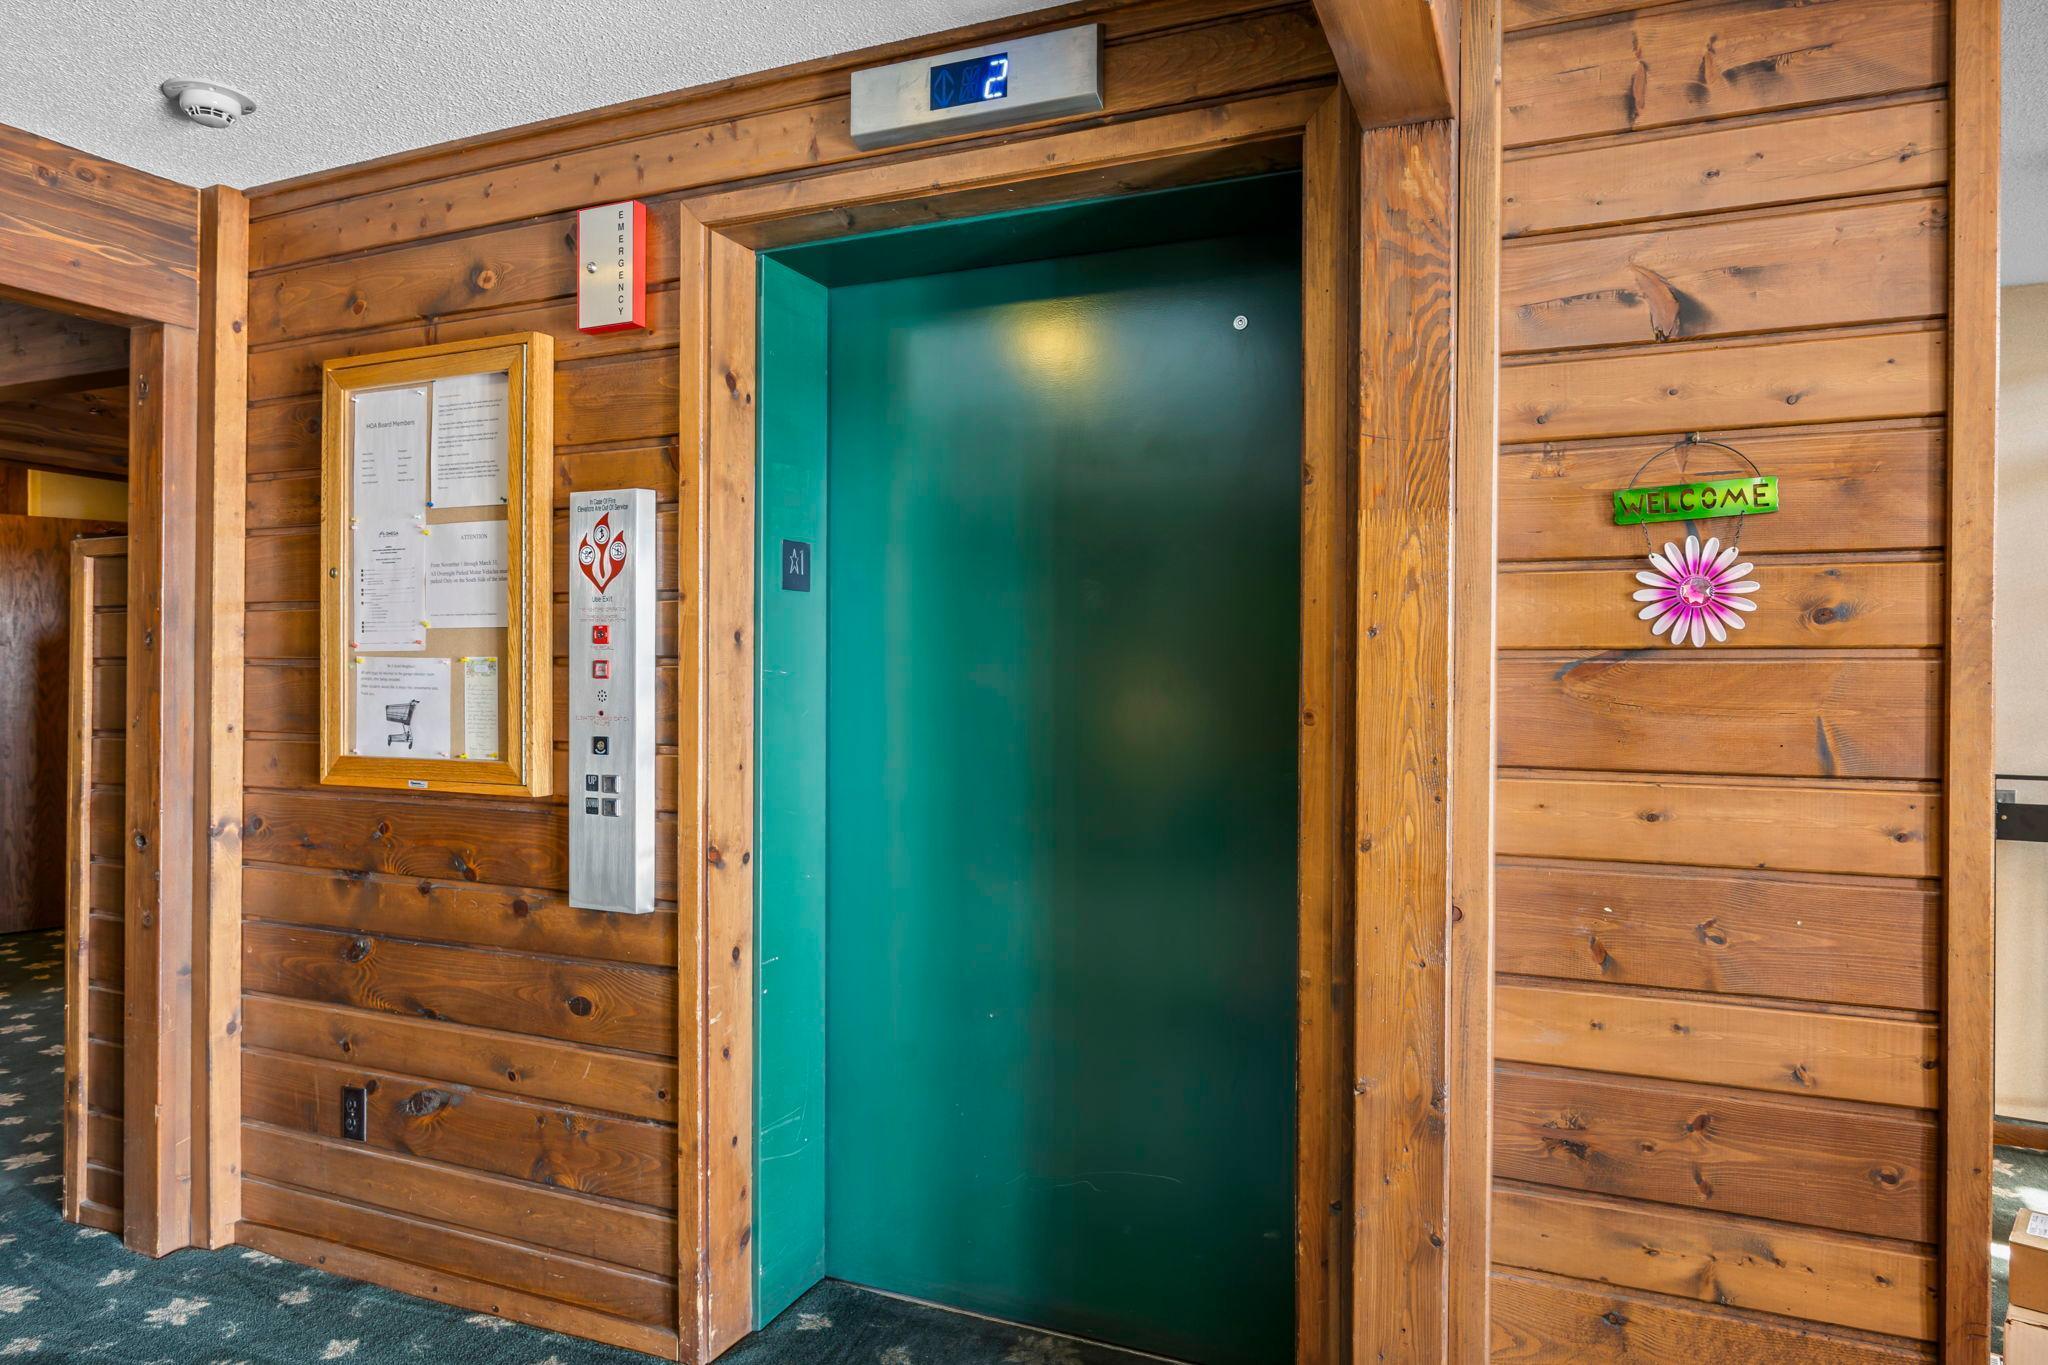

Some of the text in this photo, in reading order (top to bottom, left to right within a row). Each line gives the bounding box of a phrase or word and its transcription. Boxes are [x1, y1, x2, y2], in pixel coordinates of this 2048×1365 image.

[984, 58, 1009, 99] 2
[617, 210, 625, 316] EMERGENCY
[378, 421, 392, 429] Board
[1618, 483, 1770, 515] WELCOME
[577, 505, 594, 513] Elevators
[614, 503, 628, 511] Service
[460, 533, 488, 541] ATTENTION
[588, 775, 597, 785] UP
